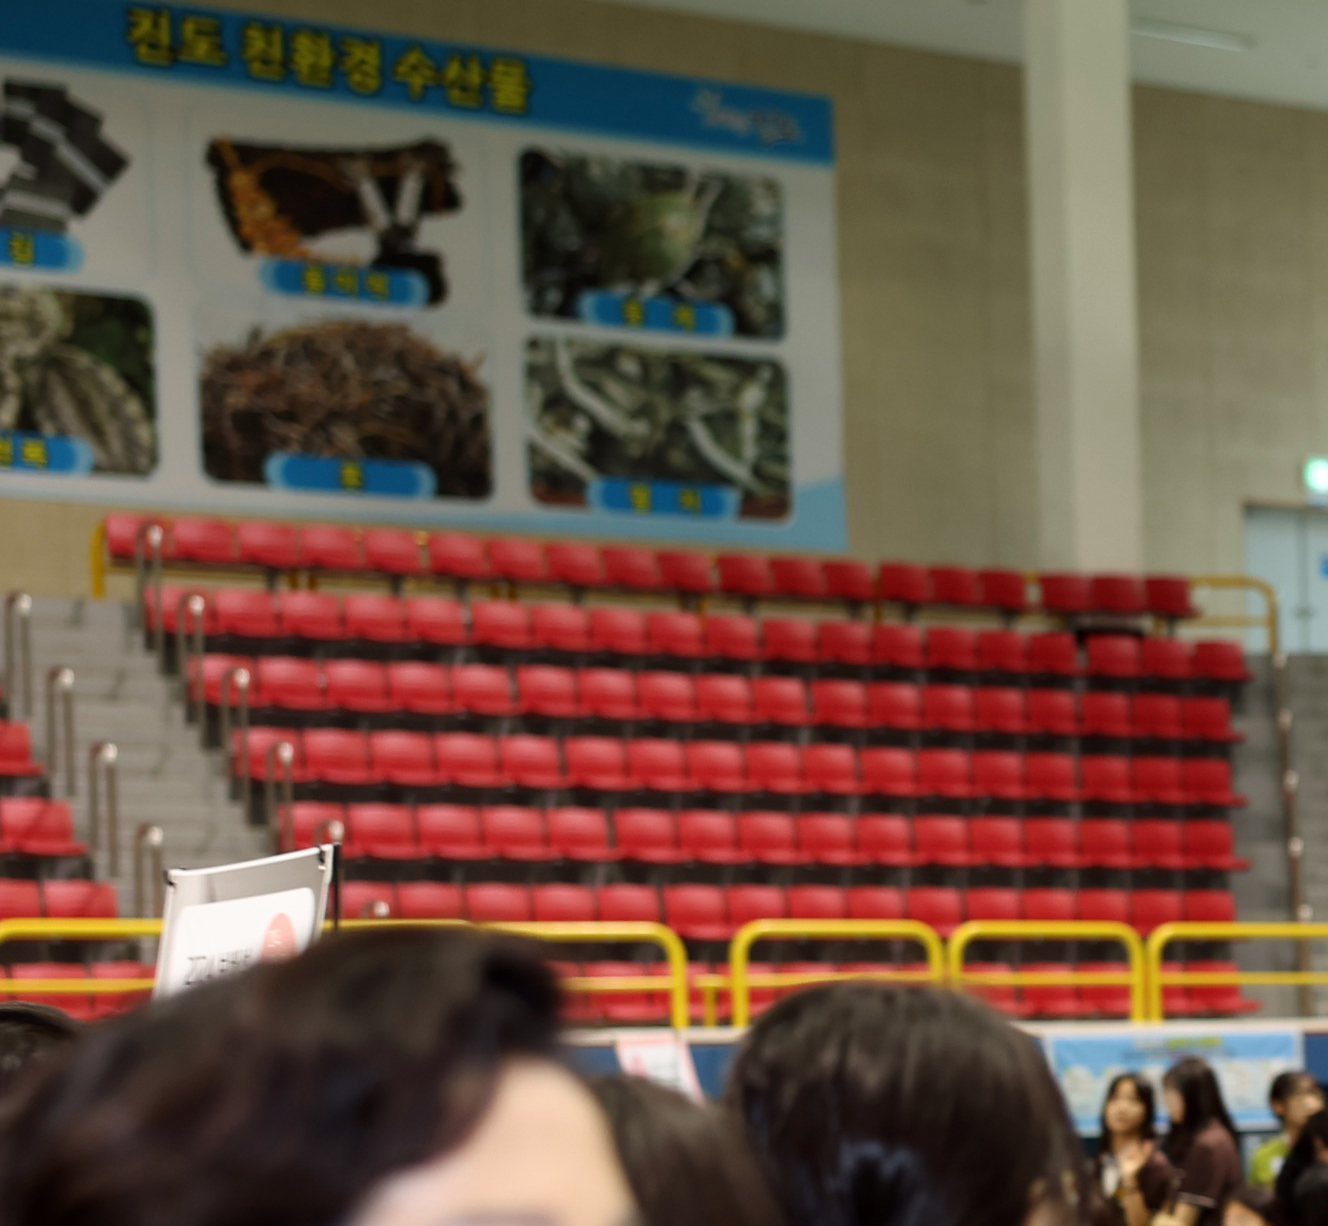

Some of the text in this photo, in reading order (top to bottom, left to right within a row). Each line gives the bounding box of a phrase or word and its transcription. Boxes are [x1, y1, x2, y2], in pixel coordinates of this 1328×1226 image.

[127, 8, 530, 114] 진도 친환경 수산물
